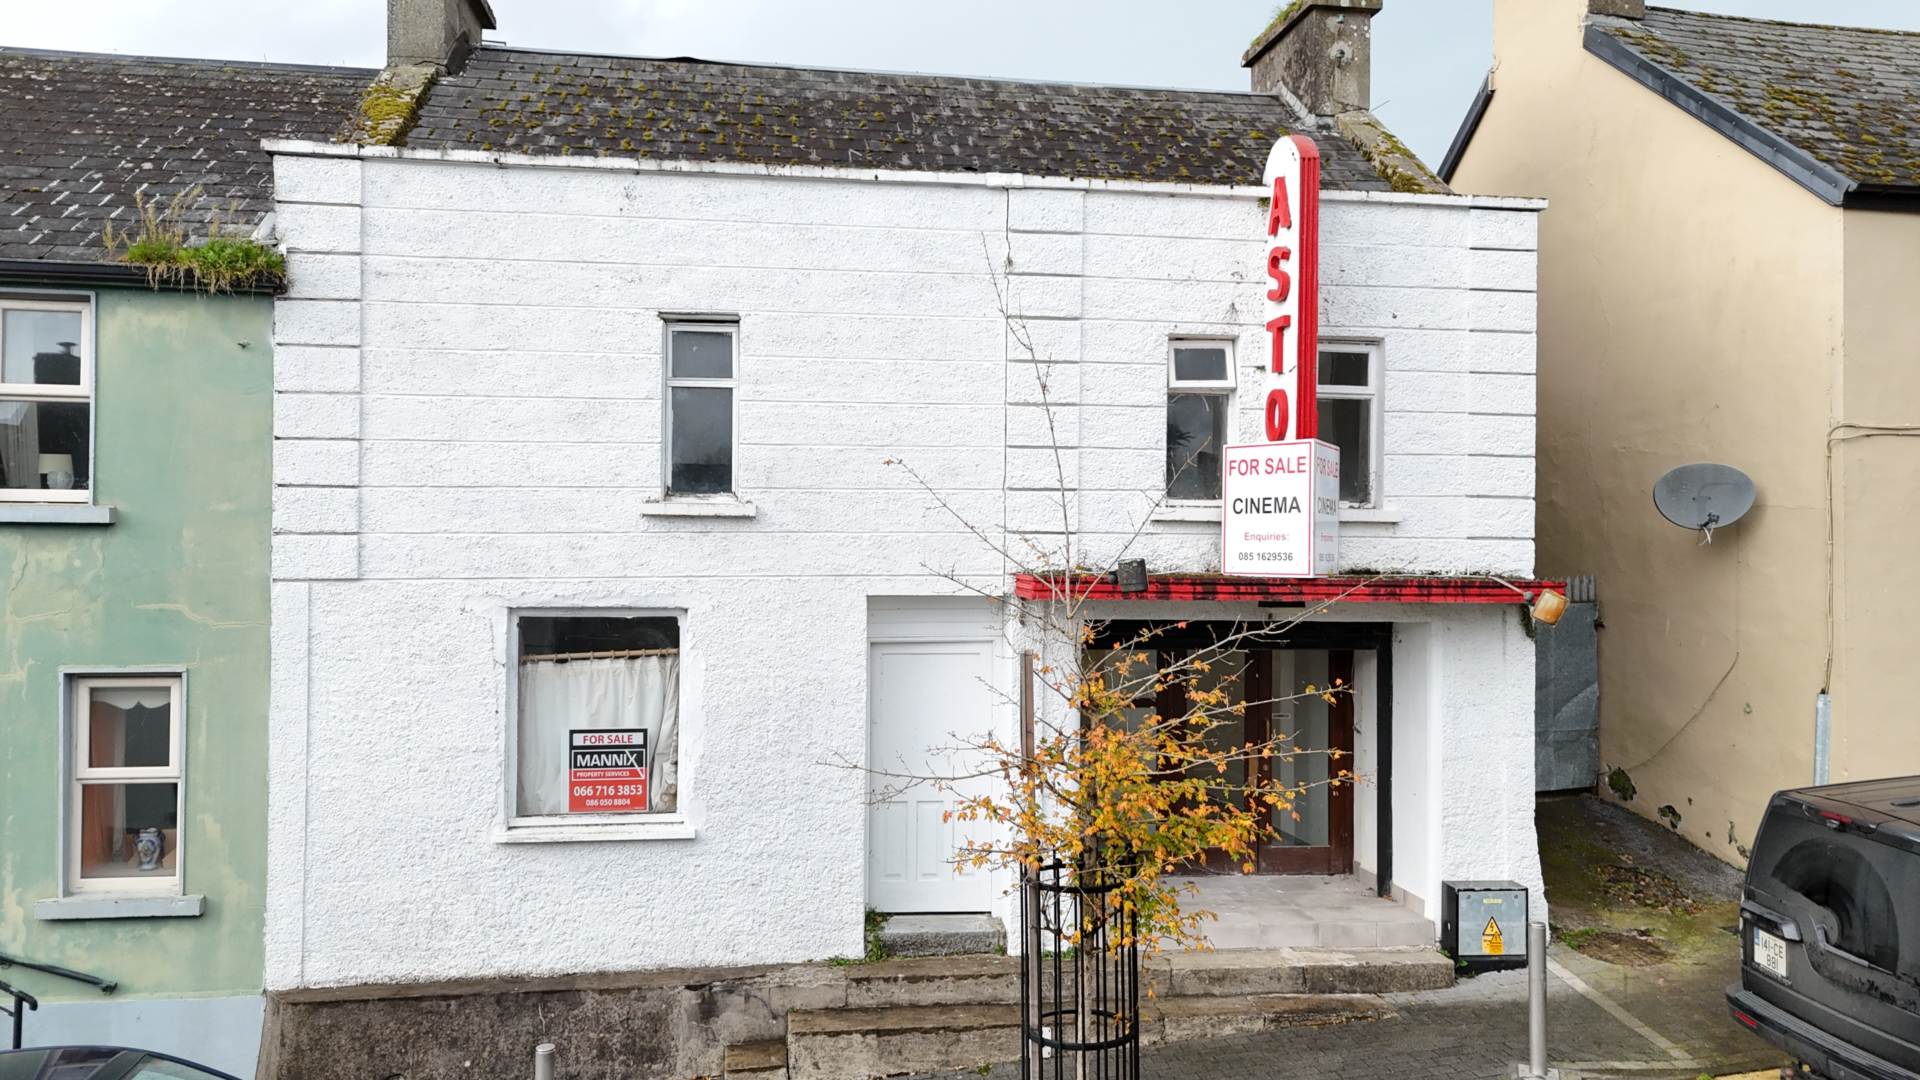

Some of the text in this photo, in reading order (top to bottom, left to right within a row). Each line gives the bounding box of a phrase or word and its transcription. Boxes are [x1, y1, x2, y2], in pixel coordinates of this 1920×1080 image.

[1229, 456, 1307, 476] FOR SALE
[1233, 496, 1301, 514] CINEMA
[1244, 531, 1290, 543] Enquiries:
[1238, 552, 1293, 561] 085 1629536
[583, 734, 633, 744] FOR SALE
[576, 753, 637, 767] MANNIX
[573, 784, 643, 796] 066 716 3853
[585, 799, 599, 807] 086
[599, 799, 613, 807] 050
[1761, 936, 1784, 959] 141-CE
